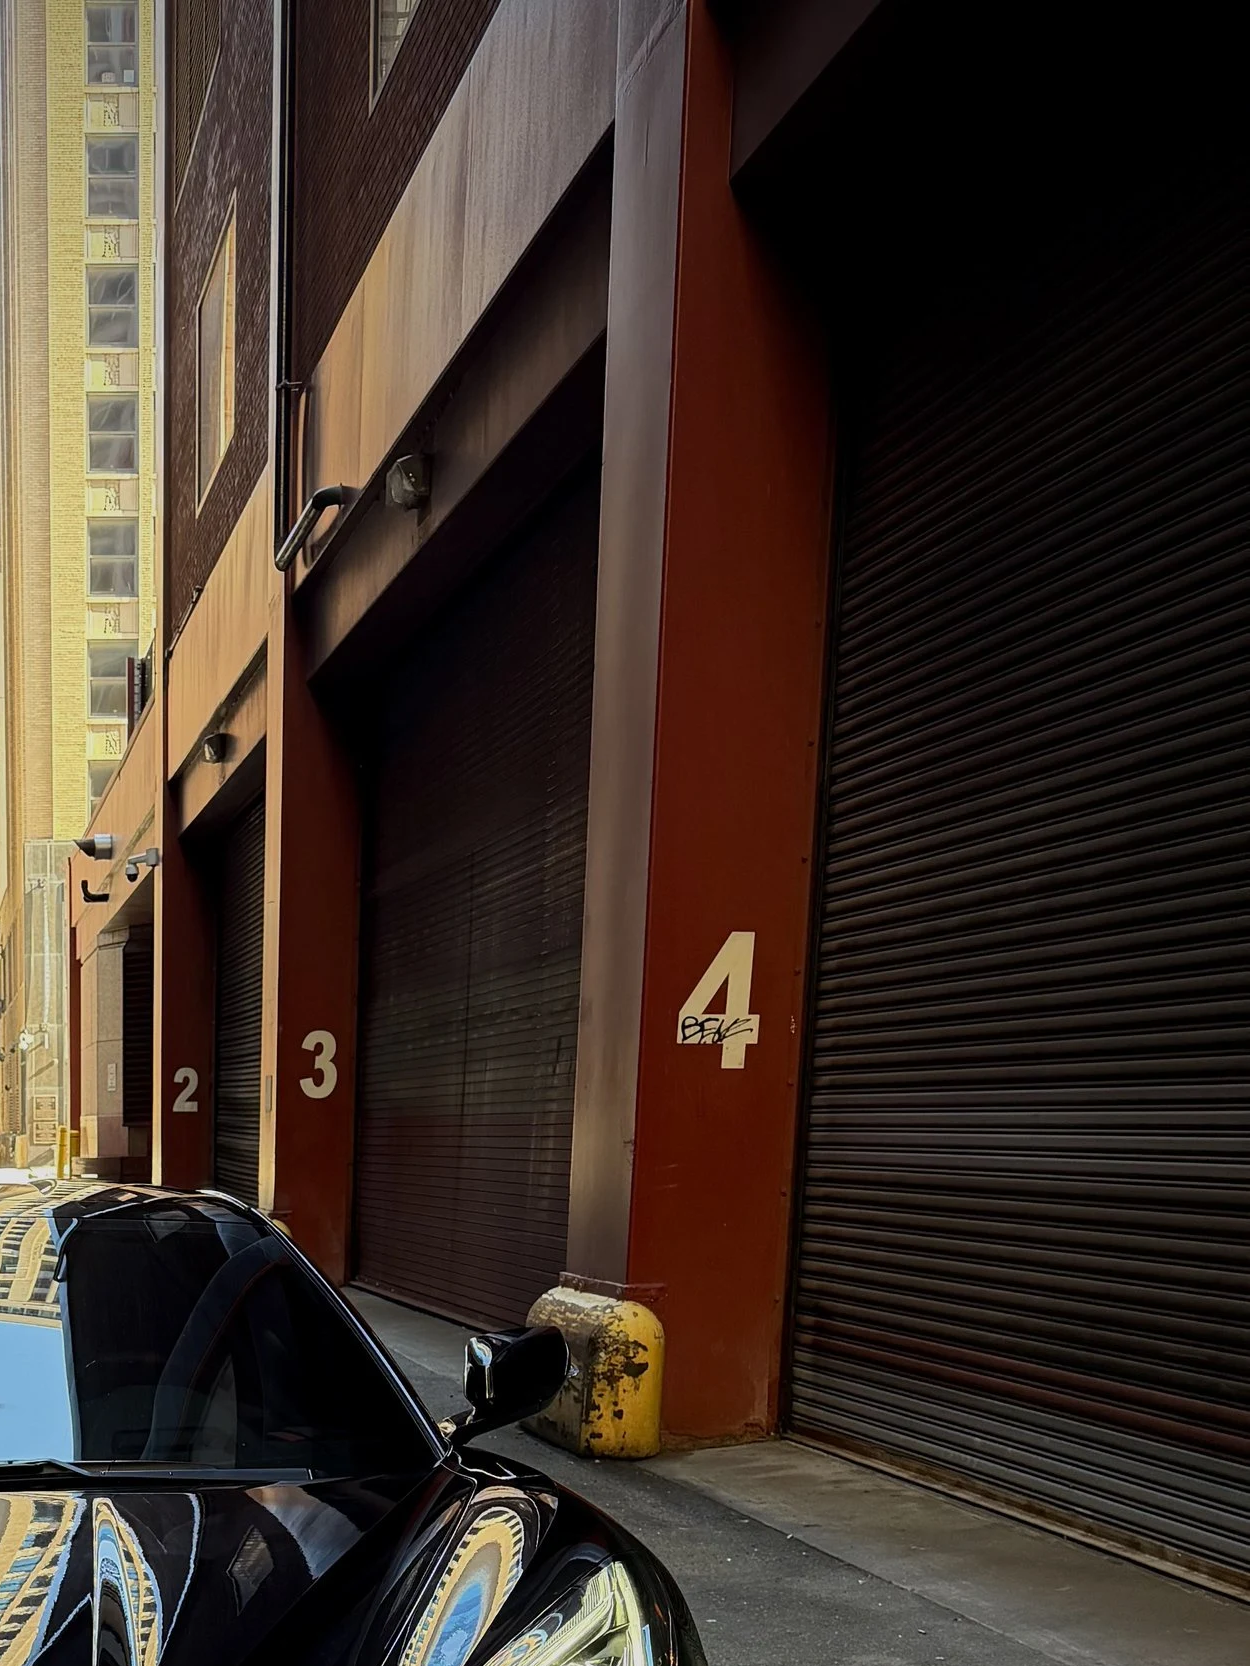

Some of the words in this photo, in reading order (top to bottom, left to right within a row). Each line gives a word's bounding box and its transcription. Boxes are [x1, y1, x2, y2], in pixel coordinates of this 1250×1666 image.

[677, 931, 760, 1069] 4
[172, 1066, 199, 1112] 2
[299, 1030, 338, 1099] 3
